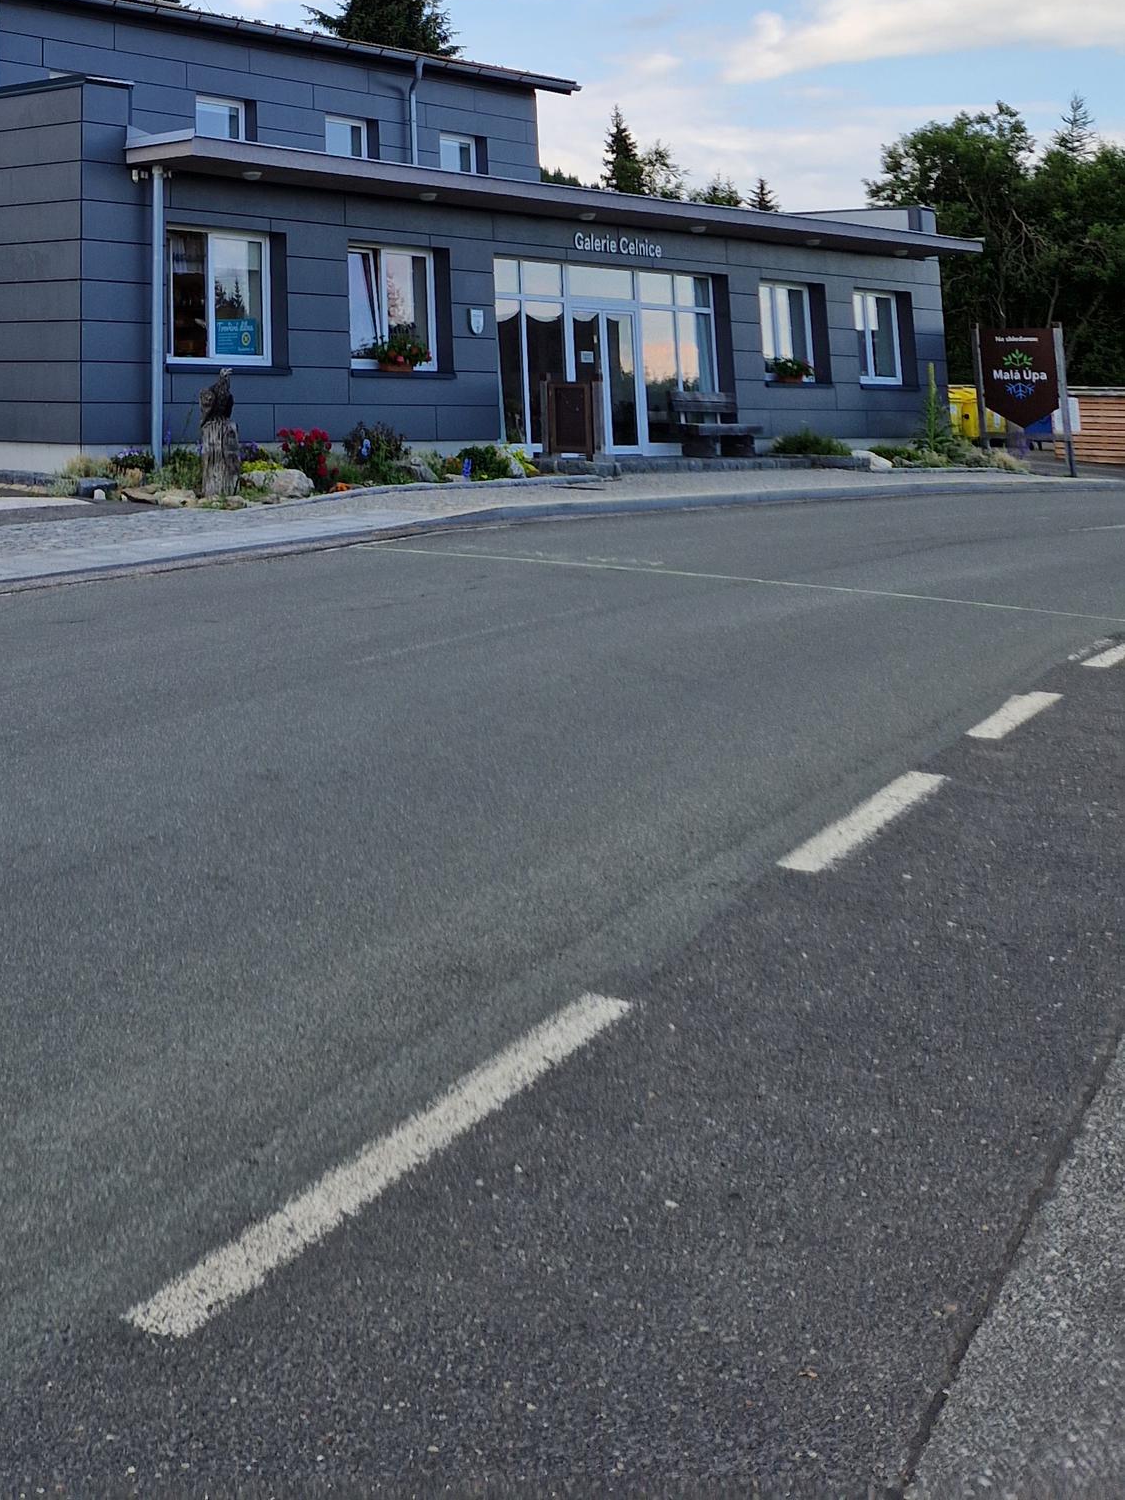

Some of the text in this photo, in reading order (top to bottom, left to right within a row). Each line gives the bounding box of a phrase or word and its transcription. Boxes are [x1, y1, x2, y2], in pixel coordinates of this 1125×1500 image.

[574, 232, 662, 258] Galerie Celnice
[992, 366, 1048, 383] Malá Úpa
